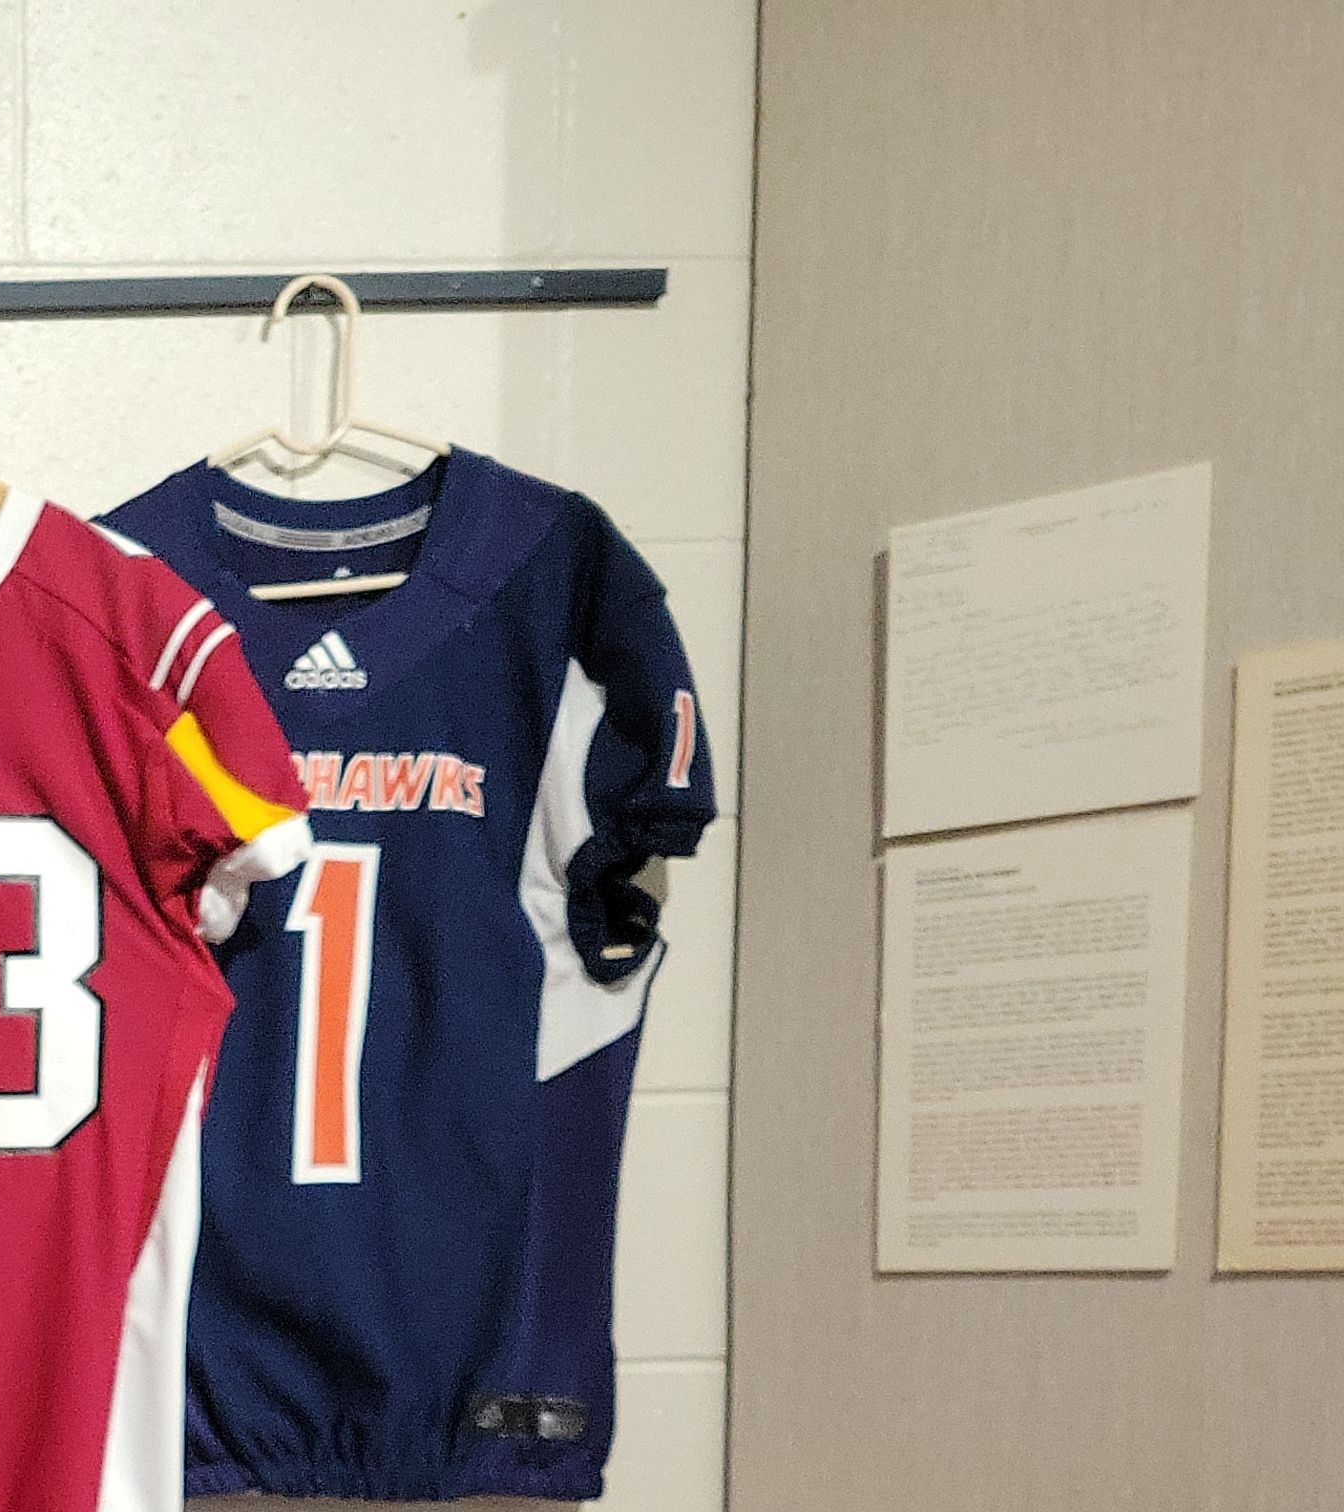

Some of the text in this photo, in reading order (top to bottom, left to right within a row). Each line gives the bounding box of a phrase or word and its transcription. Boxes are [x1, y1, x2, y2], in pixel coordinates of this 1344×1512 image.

[284, 668, 369, 691] adidas
[666, 690, 696, 789] 1
[285, 841, 381, 1185] 1
